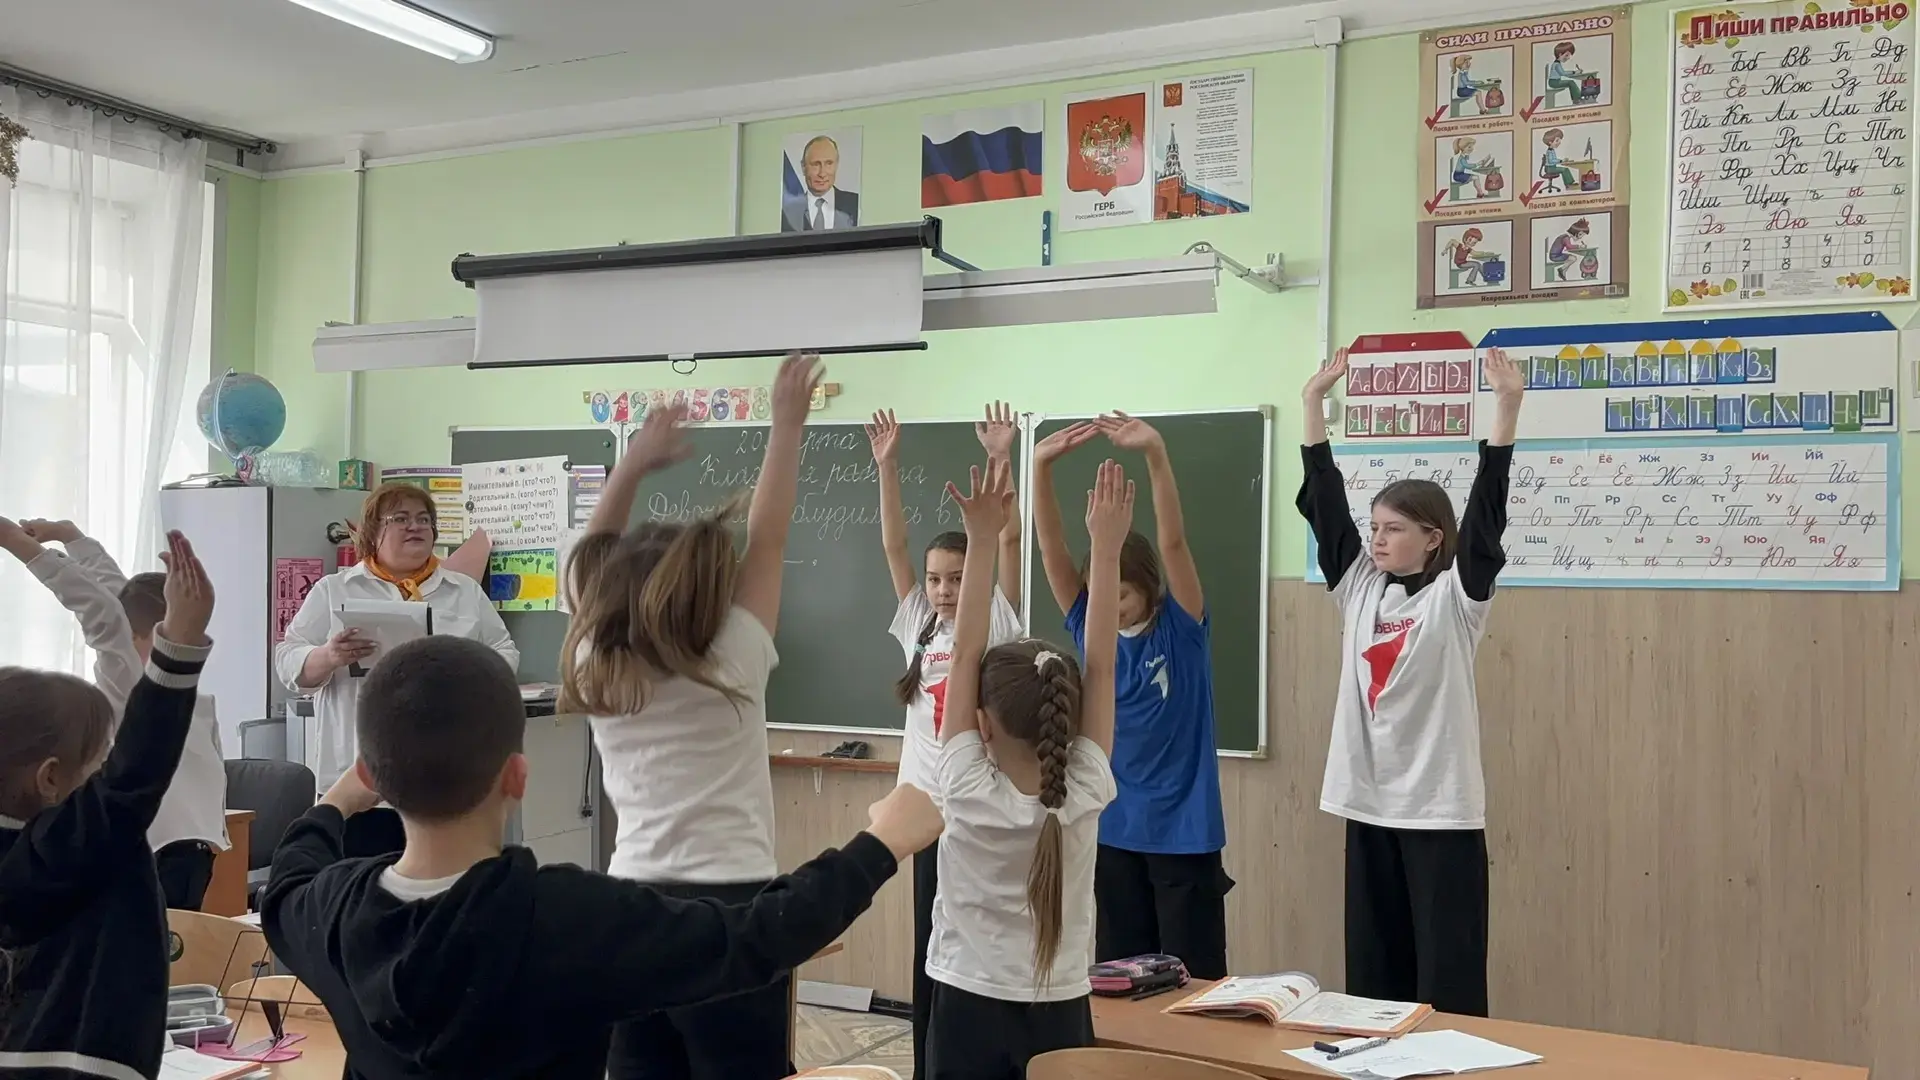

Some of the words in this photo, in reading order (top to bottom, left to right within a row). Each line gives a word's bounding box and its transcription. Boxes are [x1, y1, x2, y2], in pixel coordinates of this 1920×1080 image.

[1436, 31, 1488, 49] СИДИ
[1495, 15, 1613, 41] ПРАВИЛЬНО
[1681, 55, 1714, 77] Аа
[1731, 50, 1766, 72] Бб
[1781, 46, 1812, 68] Вв
[1870, 37, 1907, 60] Дд
[1681, 84, 1701, 103] Ее
[1761, 74, 1812, 95] Жж
[1831, 69, 1861, 95] Зз
[1873, 64, 1907, 84] Ии
[1563, 113, 1576, 121] при
[1721, 103, 1752, 125] Кк
[1765, 100, 1798, 122] Лл
[1810, 96, 1859, 117] Мм
[1872, 91, 1906, 113] Нн
[1679, 137, 1705, 157] Оо
[1718, 131, 1750, 153] Пп
[1775, 127, 1802, 154] Рр
[1824, 122, 1846, 144] Сс
[1862, 119, 1906, 141] Тт
[1677, 163, 1705, 187] Уу
[1719, 159, 1753, 185] Фф
[1771, 155, 1808, 176] Хх
[1822, 150, 1859, 176] Цц
[1094, 201, 1115, 211] ГЕРБ
[1679, 190, 1721, 211] Шш
[1075, 211, 1105, 220] Российской
[1703, 241, 1711, 253] 1
[1743, 238, 1750, 251] 2
[1782, 236, 1790, 249] 3
[1824, 234, 1832, 245] 4
[1864, 231, 1873, 243] 5
[1702, 262, 1711, 274] 6
[1742, 260, 1750, 272] 7
[1782, 258, 1790, 270] 8
[1821, 256, 1831, 268] 9
[1370, 459, 1384, 468] Бб
[1459, 457, 1470, 465] Гг
[1550, 456, 1563, 464] Ее
[1599, 455, 1612, 463] Ёё
[1639, 454, 1660, 463] Жж
[1700, 453, 1714, 462] Зз
[1752, 452, 1769, 461] Ии
[1805, 449, 1824, 460] Йй
[1516, 466, 1547, 492] Дд
[1569, 466, 1590, 487] Ее
[1653, 466, 1704, 486] Жж
[1719, 464, 1744, 492] Зз
[1768, 464, 1798, 484] Ии
[1828, 460, 1861, 484] Йй
[1511, 496, 1526, 504] Оо
[1605, 495, 1620, 504] Рр
[1767, 493, 1782, 503] Уу
[1815, 492, 1837, 503] Фф
[1530, 507, 1552, 527] Оо
[1568, 505, 1603, 526] Пп
[1623, 506, 1654, 533] Рр
[1719, 505, 1763, 526] Тт
[1839, 503, 1876, 533] Фф
[1525, 535, 1547, 545] Щщ
[1696, 536, 1711, 544] Ээ
[1744, 536, 1767, 544] Юю
[1809, 535, 1826, 544] Яя
[1709, 545, 1733, 567] Ээ
[1761, 545, 1796, 568] Юю
[1824, 544, 1862, 568] Яя
